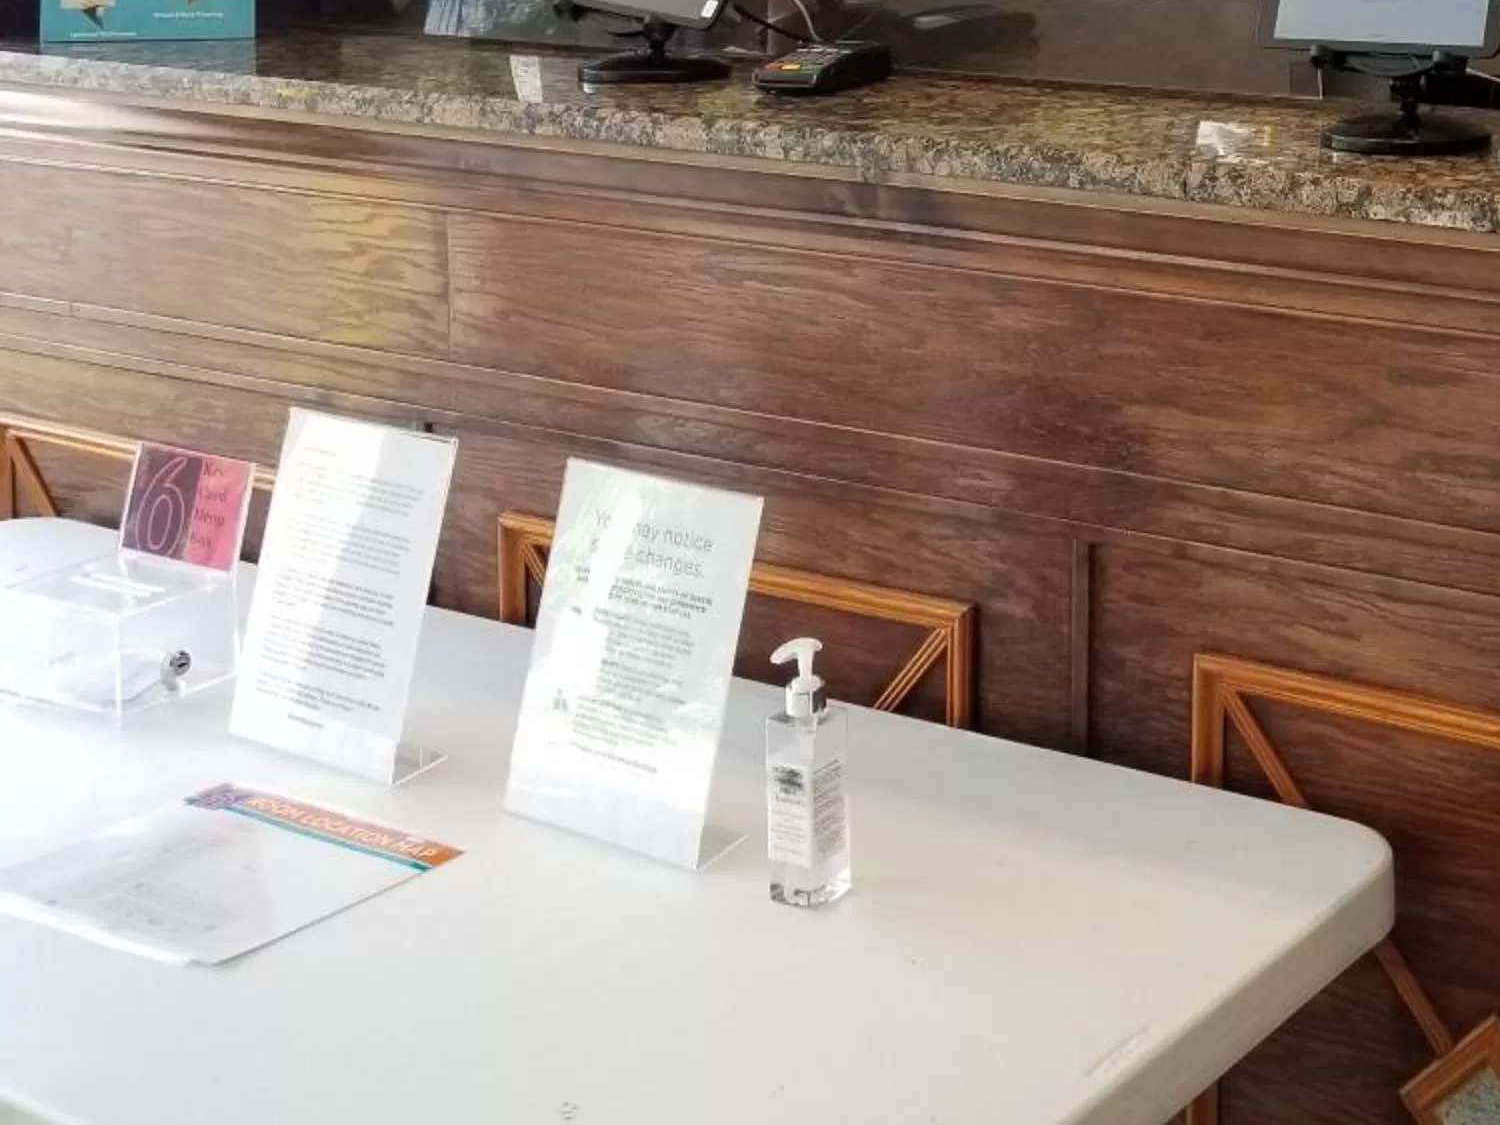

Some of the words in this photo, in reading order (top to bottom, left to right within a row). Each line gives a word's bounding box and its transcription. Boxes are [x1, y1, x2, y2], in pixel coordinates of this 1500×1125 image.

[662, 528, 715, 552] notice
[301, 813, 391, 846] LOCATION
[395, 839, 437, 858] MAP
